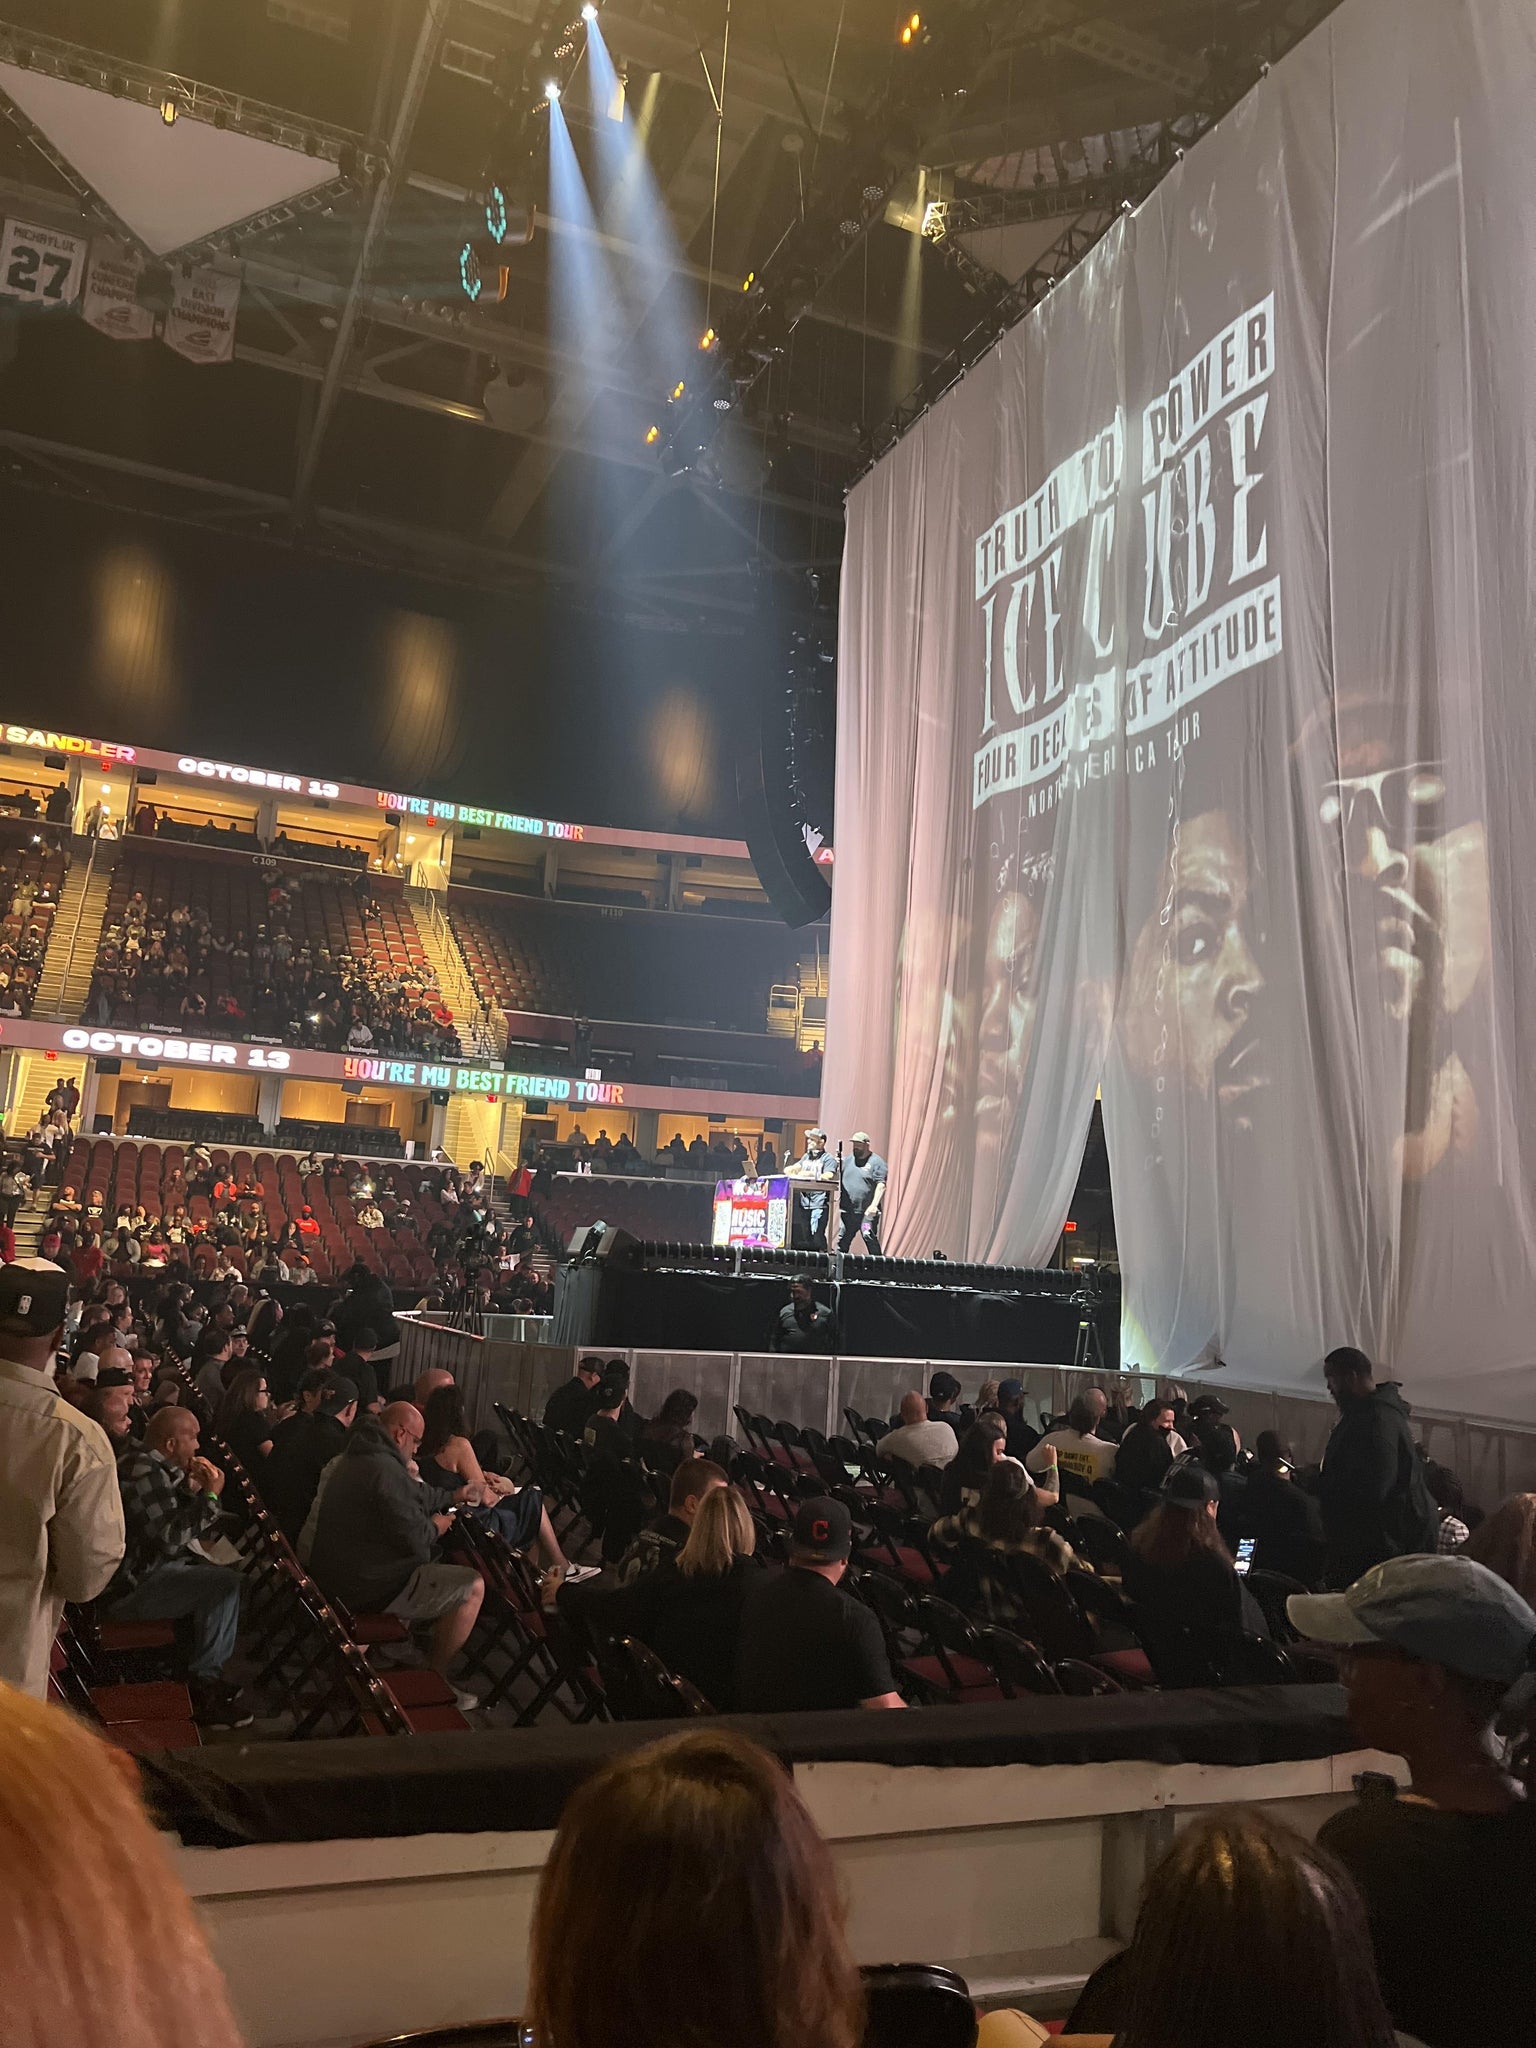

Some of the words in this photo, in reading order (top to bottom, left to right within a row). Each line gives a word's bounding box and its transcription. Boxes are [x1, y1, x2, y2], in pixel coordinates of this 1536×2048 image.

[7, 245, 73, 299] 27
[980, 469, 1061, 588] TRUTH
[1081, 431, 1115, 496] TO
[1149, 311, 1268, 469] POWER
[981, 546, 1064, 735] ICE
[1082, 391, 1269, 659] CUBE
[978, 742, 1017, 796] FOUR
[1128, 673, 1153, 723] OF
[1166, 593, 1277, 706] ATTITUDE
[6, 726, 136, 762] SANDLER
[177, 758, 301, 792] OCTOBER
[308, 781, 340, 798] 13
[377, 791, 430, 816] YOU'RE
[433, 801, 456, 821] MY
[459, 806, 494, 827] BEST
[495, 812, 543, 837] FRIEND
[547, 820, 584, 841] TOUR
[260, 857, 277, 867] 109
[62, 1028, 238, 1064] OCTOBER
[247, 1049, 291, 1069] 13
[343, 1056, 416, 1081] YOU'RE
[421, 1065, 451, 1088] MY
[456, 1069, 504, 1092] BEST
[505, 1073, 569, 1099] FRIEND
[575, 1081, 624, 1104] TOUR
[811, 1519, 830, 1542] C
